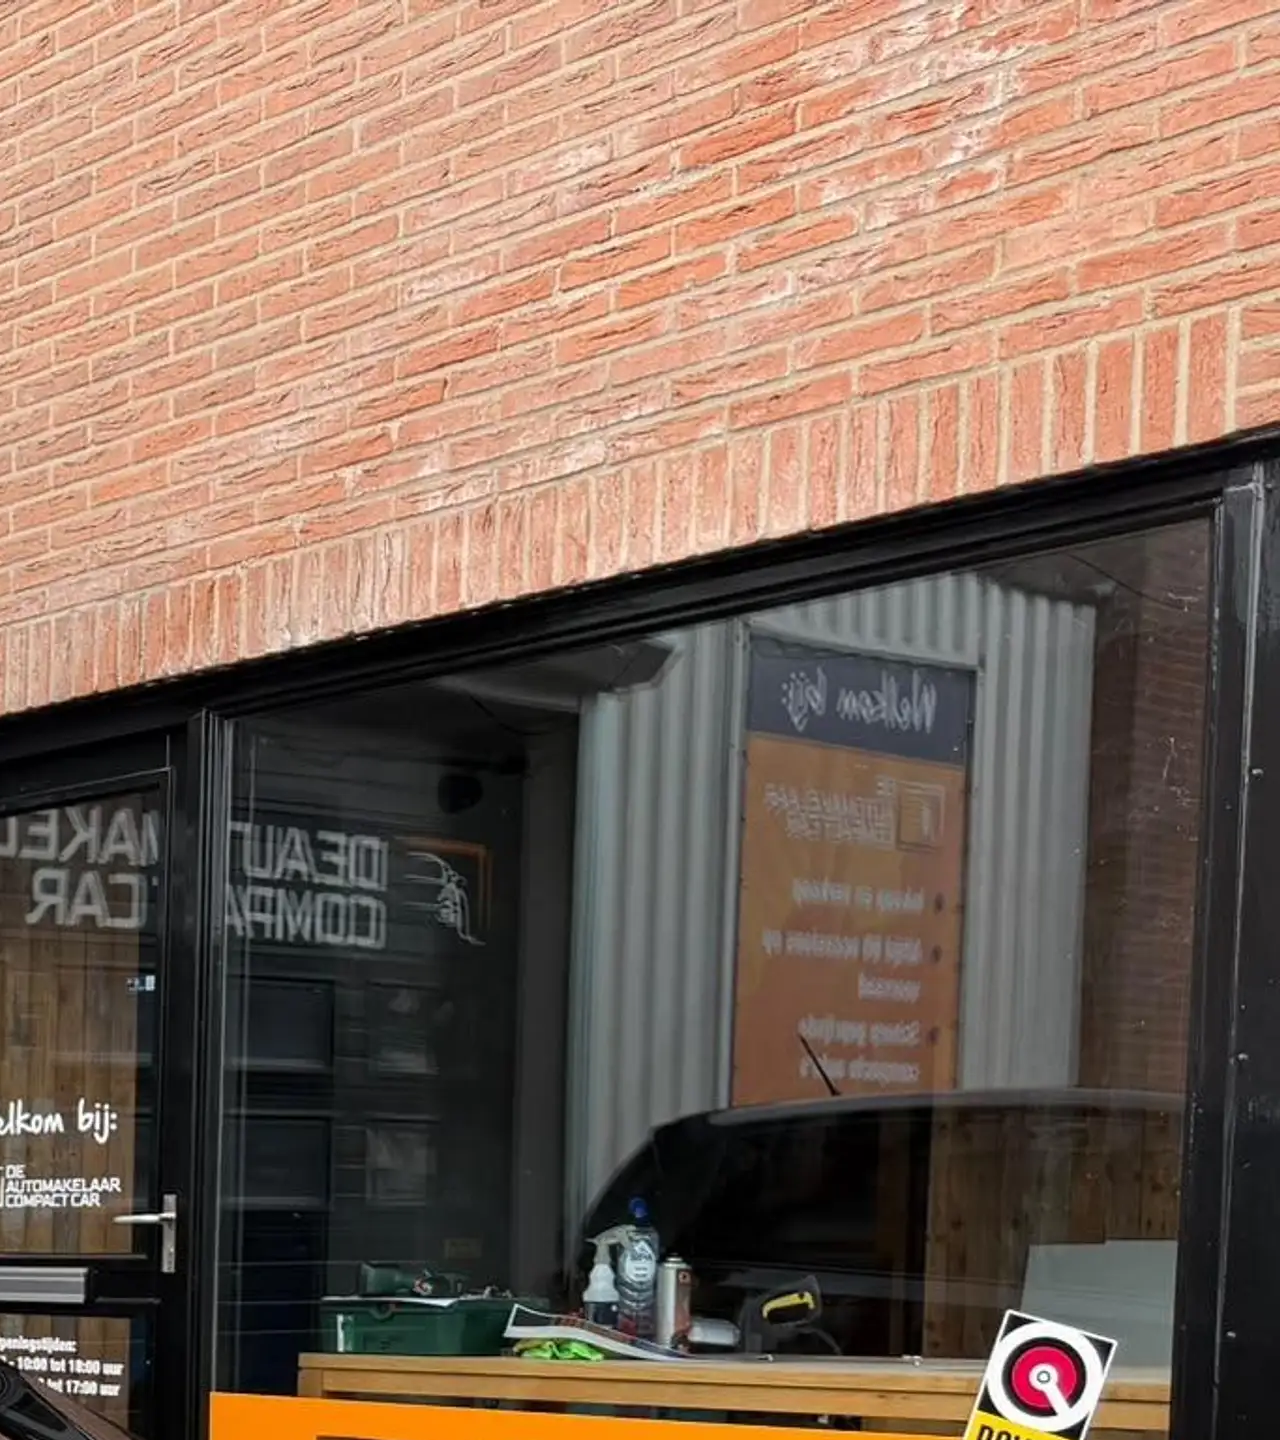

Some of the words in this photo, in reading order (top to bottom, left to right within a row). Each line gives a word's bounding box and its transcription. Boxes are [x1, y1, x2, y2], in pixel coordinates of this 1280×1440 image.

[77, 1098, 118, 1145] bij:
[5, 1164, 27, 1179] DE
[5, 1177, 122, 1193] AUTOMAKELAAR
[5, 1192, 69, 1208] COMPACT
[71, 1193, 101, 1208] CAR
[17, 1356, 48, 1371] 10:00
[50, 1357, 66, 1373] tot
[68, 1358, 100, 1375] 18:00
[102, 1362, 124, 1376] uur
[66, 1379, 98, 1395] 17:00
[99, 1383, 121, 1396] uur
